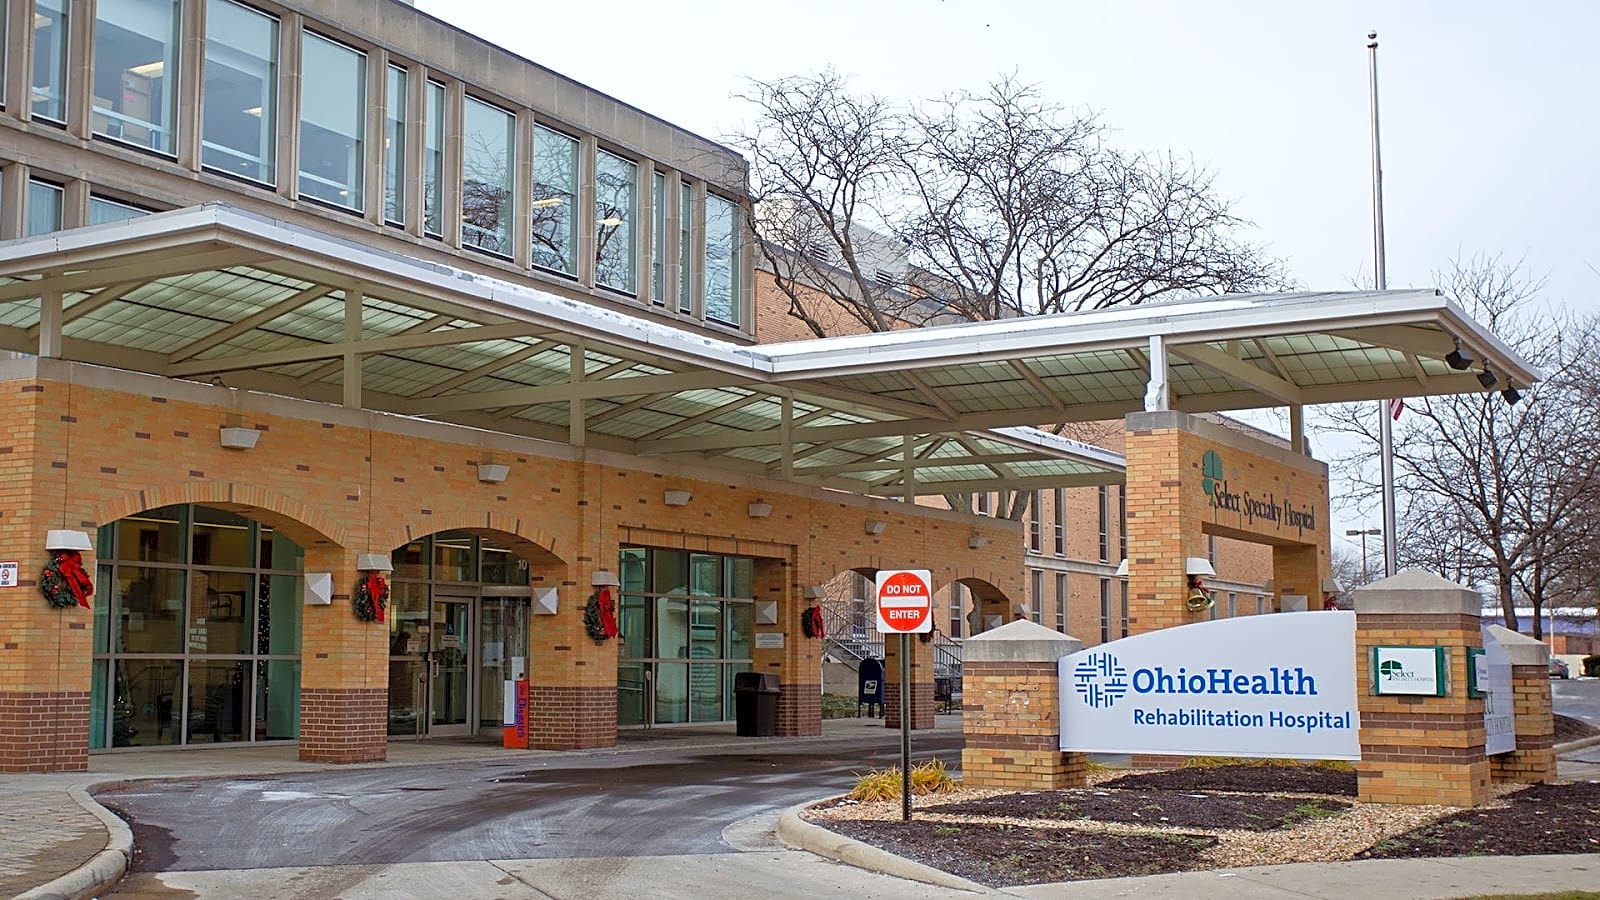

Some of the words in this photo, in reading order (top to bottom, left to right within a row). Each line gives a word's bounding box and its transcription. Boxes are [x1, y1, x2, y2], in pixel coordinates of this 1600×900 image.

[1214, 480, 1241, 512] Select
[1243, 491, 1282, 530] Specialty
[1284, 499, 1315, 537] Hospital
[517, 559, 528, 570] 10
[886, 584, 901, 594] DO
[902, 584, 921, 594] NOT
[889, 610, 920, 619] ENTER
[1391, 669, 1414, 677] Select
[1132, 667, 1318, 695] OhioHealth
[1134, 708, 1264, 728] Rehabilitation
[1269, 710, 1351, 733] Hospital
